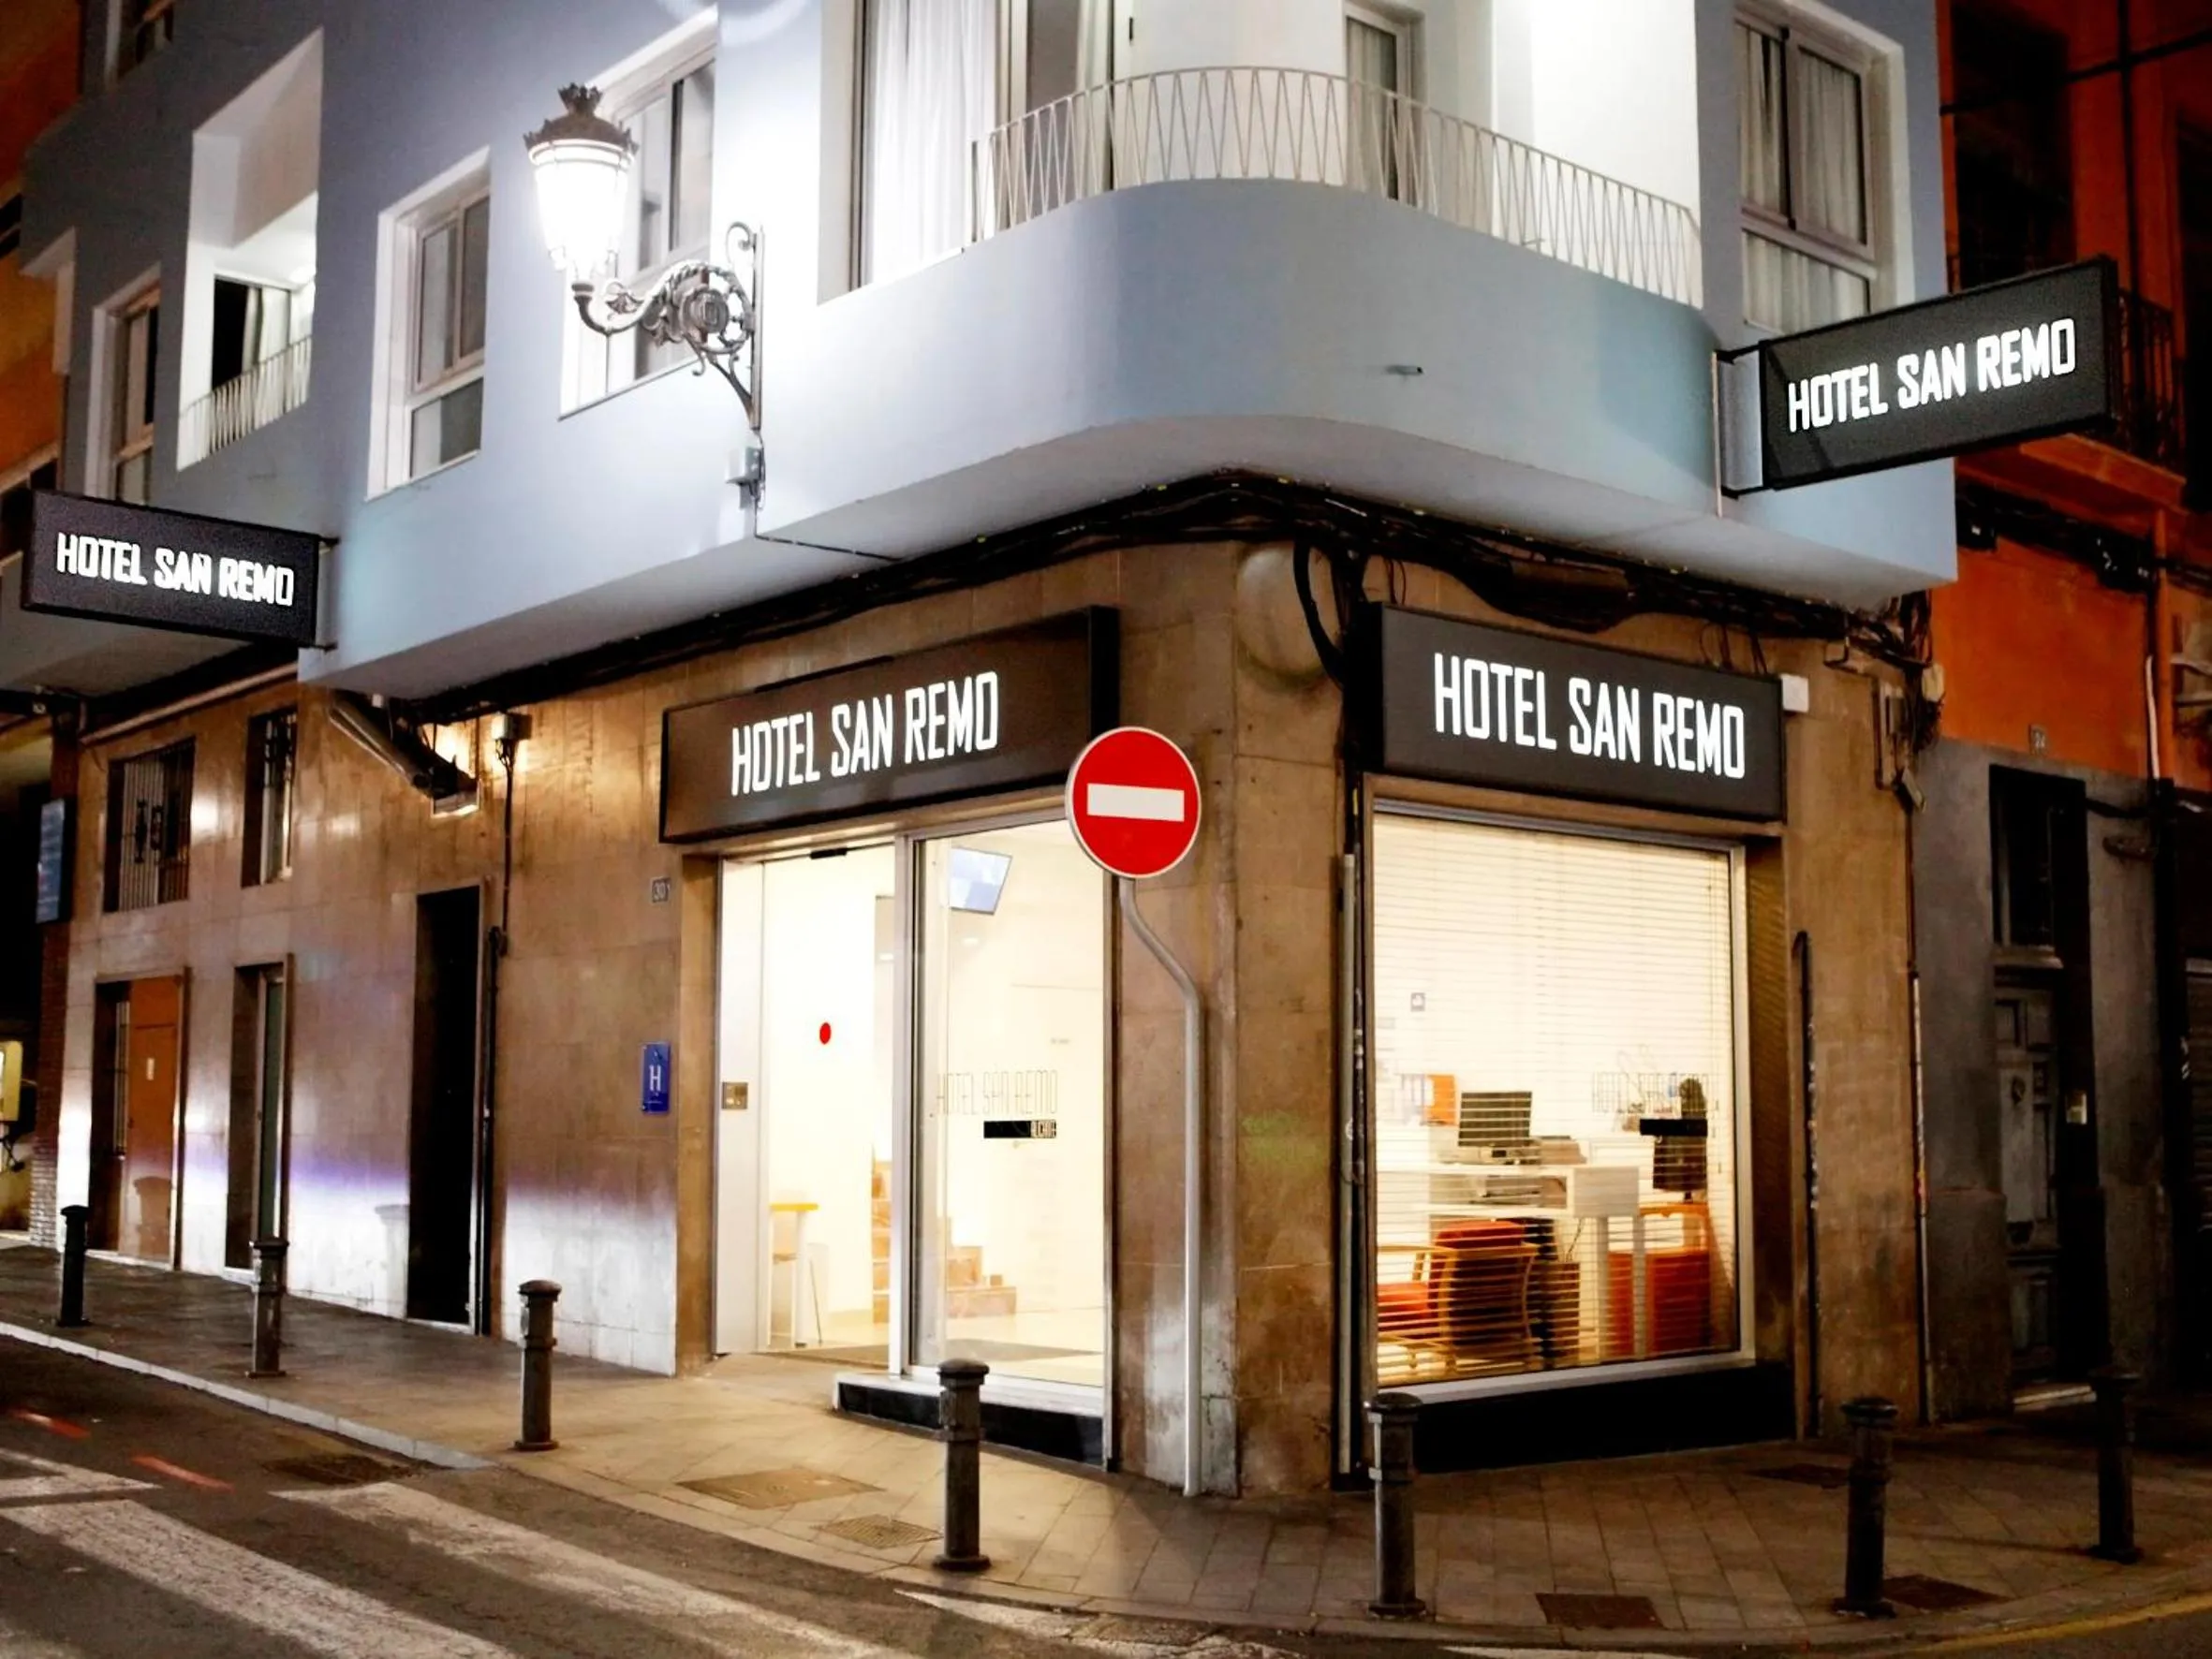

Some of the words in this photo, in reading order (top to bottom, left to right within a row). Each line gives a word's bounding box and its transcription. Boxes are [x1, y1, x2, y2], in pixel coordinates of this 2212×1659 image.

[1788, 361, 1889, 433] HOTEL
[1896, 342, 1966, 409] SAN
[1976, 318, 2076, 392] REMO
[56, 532, 147, 586] HOTEL
[154, 547, 212, 595] SAN
[218, 556, 294, 607] REMO
[730, 711, 821, 797] HOTEL
[831, 693, 893, 778] SAN
[904, 670, 999, 765] REMO
[1434, 653, 1557, 750] HOTEL
[1569, 677, 1641, 763] SAN
[1653, 692, 1746, 779] REMO
[649, 1064, 661, 1092] H
